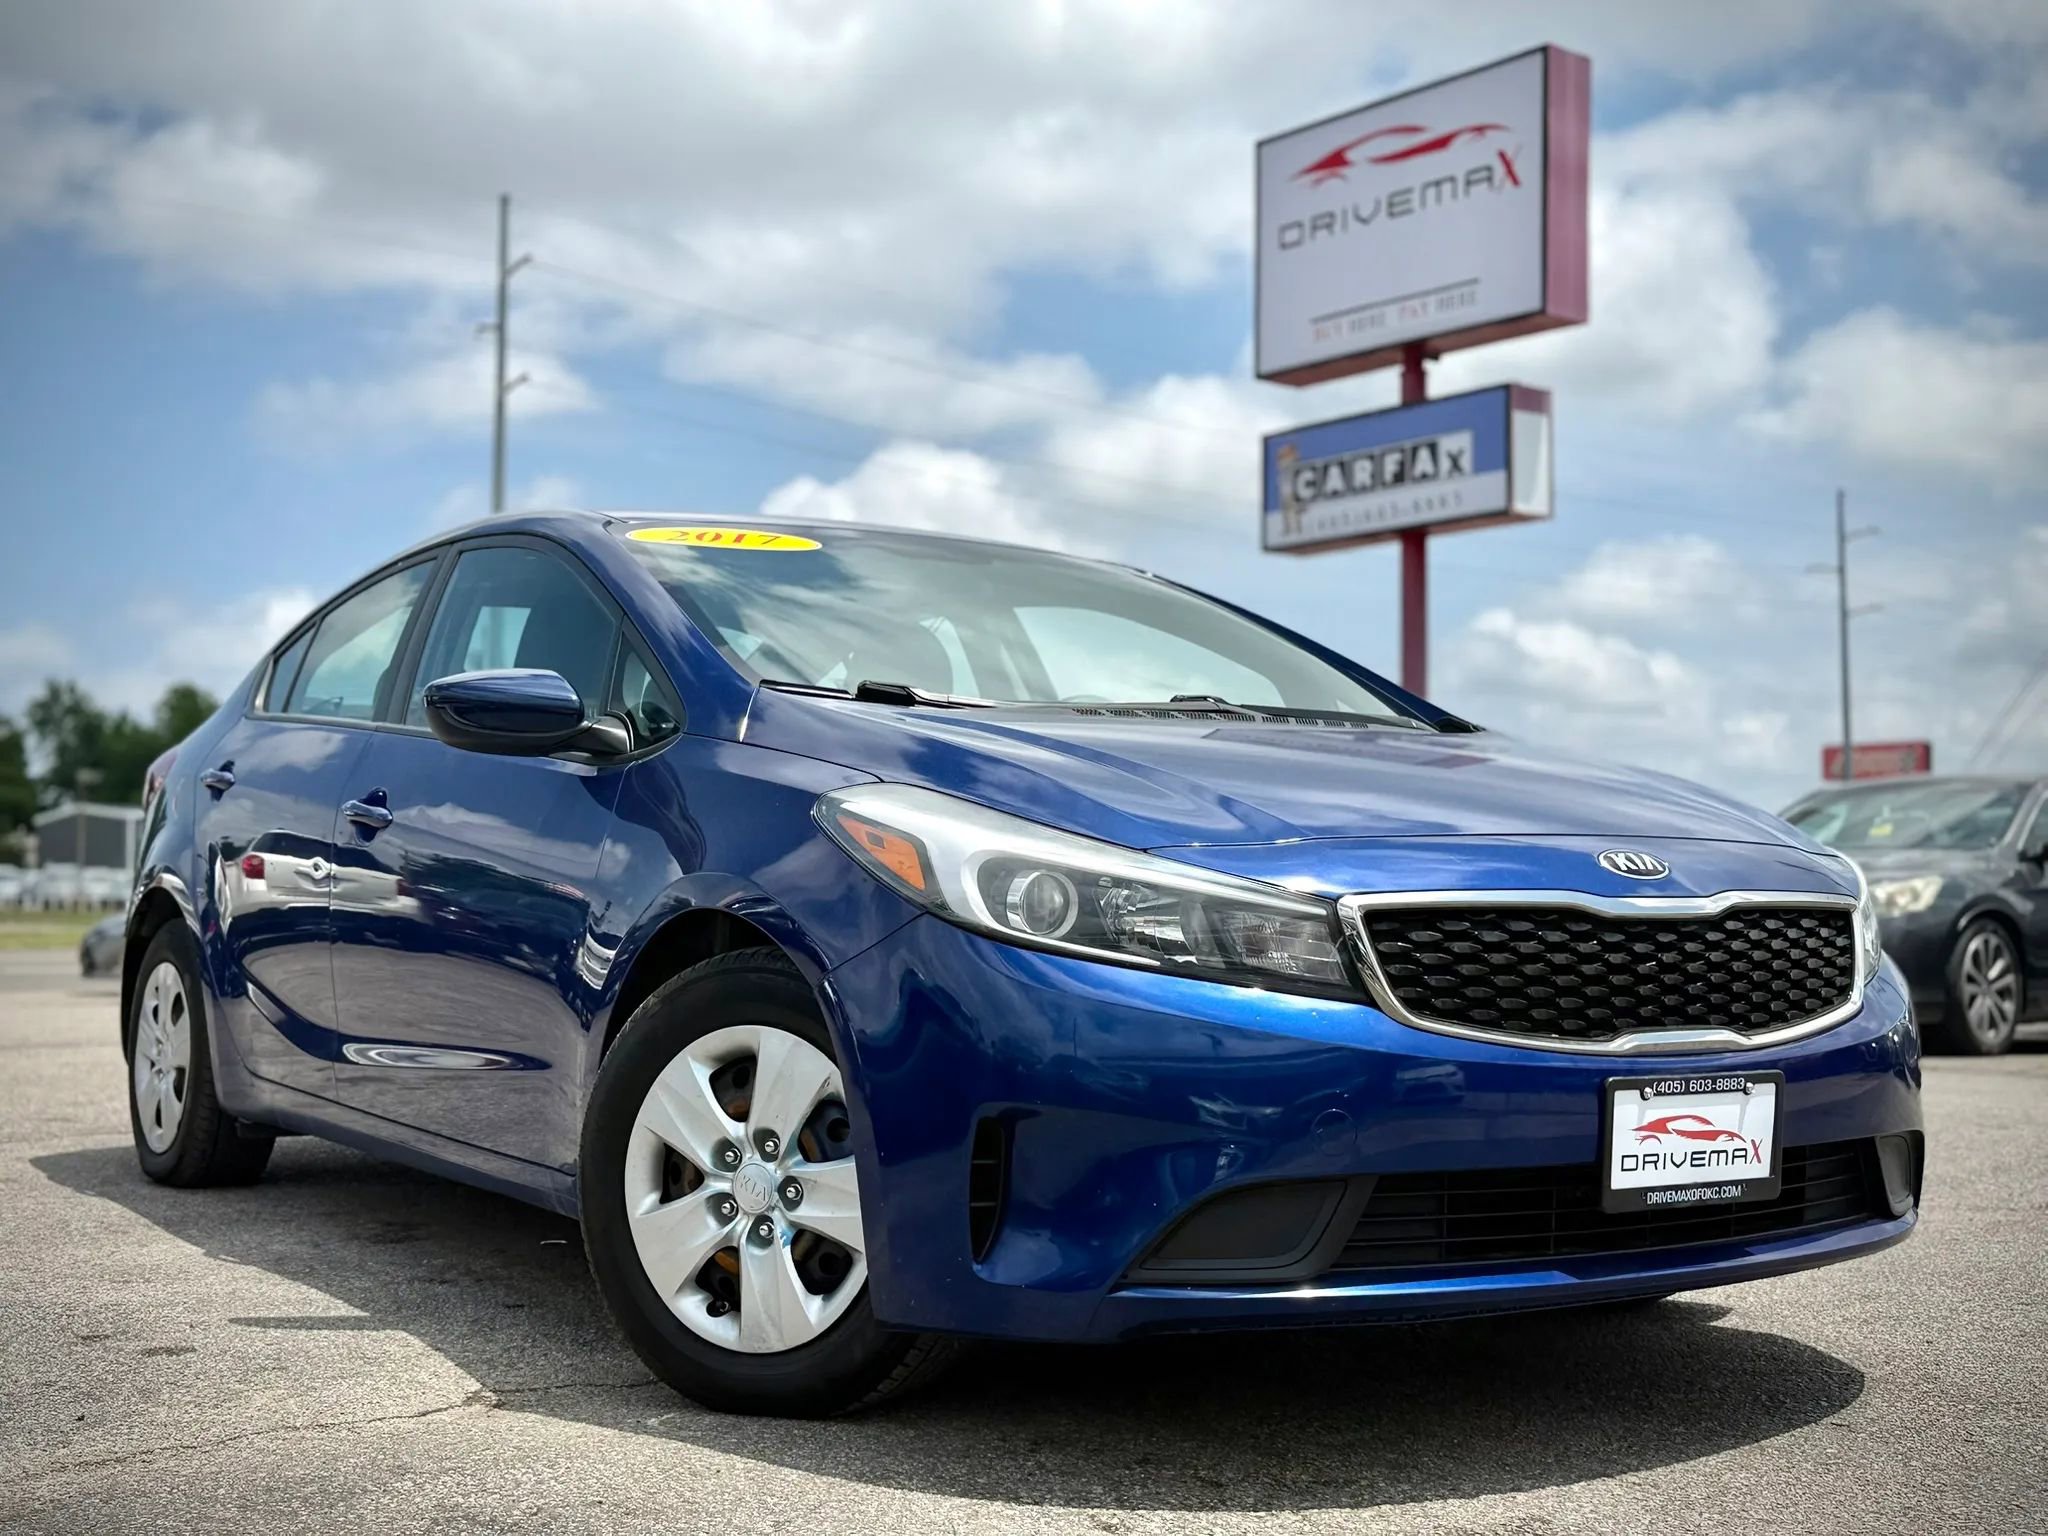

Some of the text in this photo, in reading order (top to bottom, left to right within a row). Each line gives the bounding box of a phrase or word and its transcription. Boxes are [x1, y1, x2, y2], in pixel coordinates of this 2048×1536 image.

[1277, 144, 1521, 251] DRIVEMAX
[1295, 444, 1465, 500] CARFAX
[667, 531, 781, 545] 2017
[1606, 852, 1664, 871] KIA
[1653, 1078, 1745, 1093] (405) 603-8883
[1621, 1138, 1763, 1172] DRIVEMAX
[739, 1175, 767, 1202] KIA
[1647, 1185, 1741, 1204] DRIVEMAXOFOKC.COM
